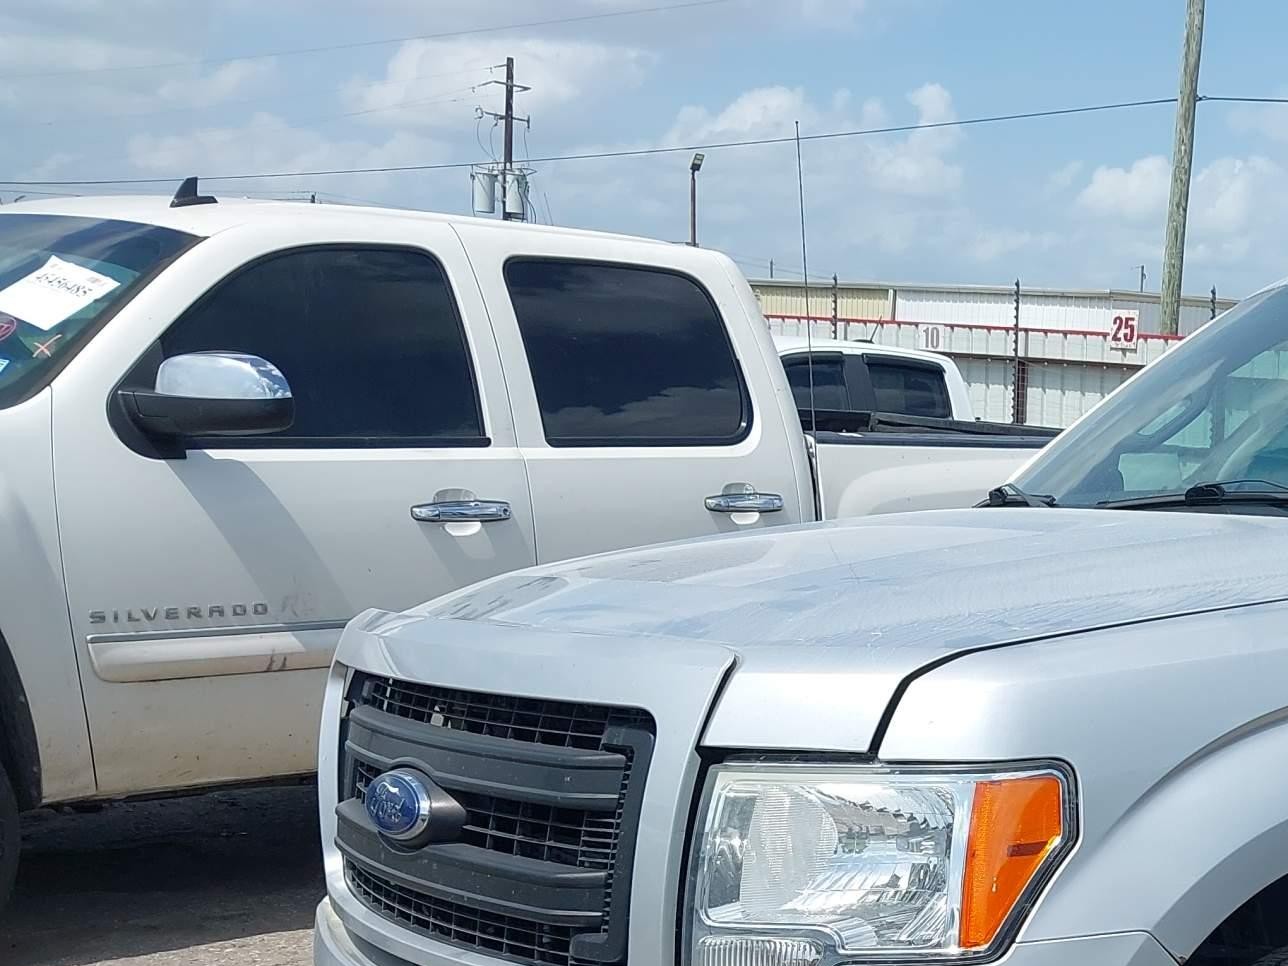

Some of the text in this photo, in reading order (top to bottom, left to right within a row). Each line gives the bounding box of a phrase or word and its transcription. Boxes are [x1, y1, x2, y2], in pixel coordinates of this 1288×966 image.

[923, 326, 941, 350] 10
[1112, 315, 1136, 343] 25
[88, 602, 269, 625] SILVERADO
[369, 781, 407, 823] Ford
